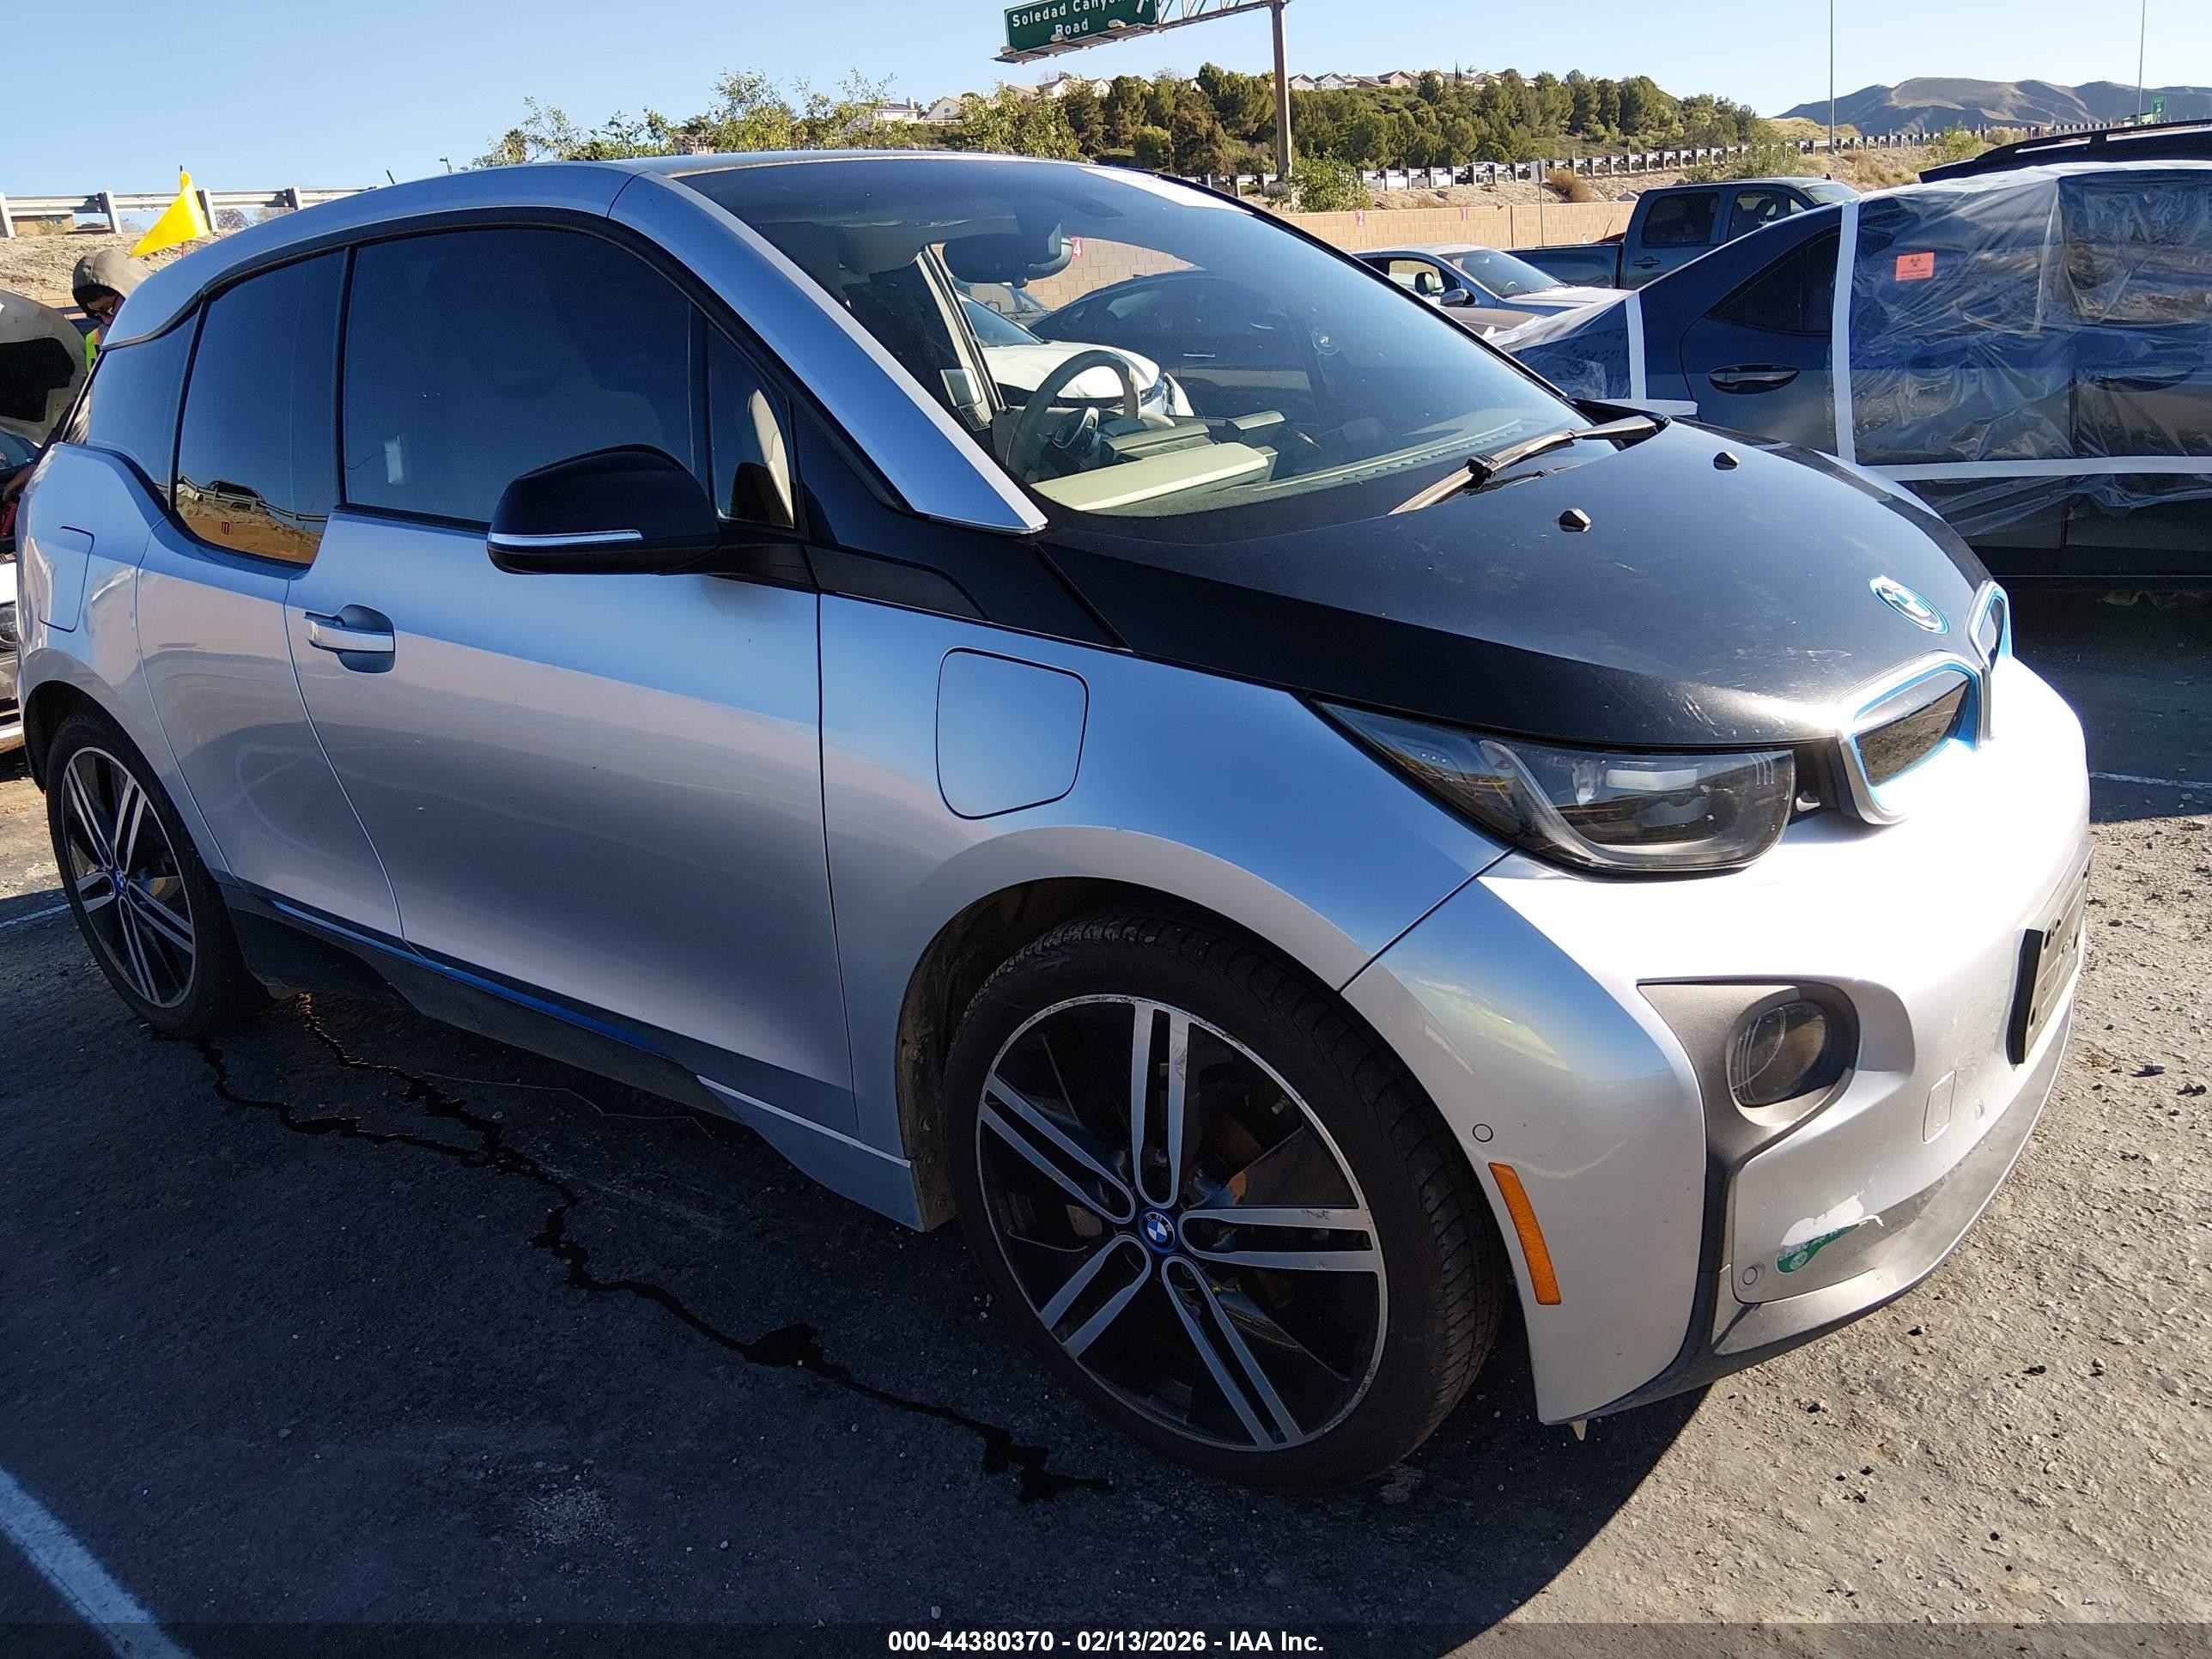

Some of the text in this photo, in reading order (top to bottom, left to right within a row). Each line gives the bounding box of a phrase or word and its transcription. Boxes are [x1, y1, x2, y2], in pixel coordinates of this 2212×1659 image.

[1012, 0, 1125, 27] Soledad Cany
[1055, 18, 1089, 35] Road
[1073, 240, 1082, 257] 4
